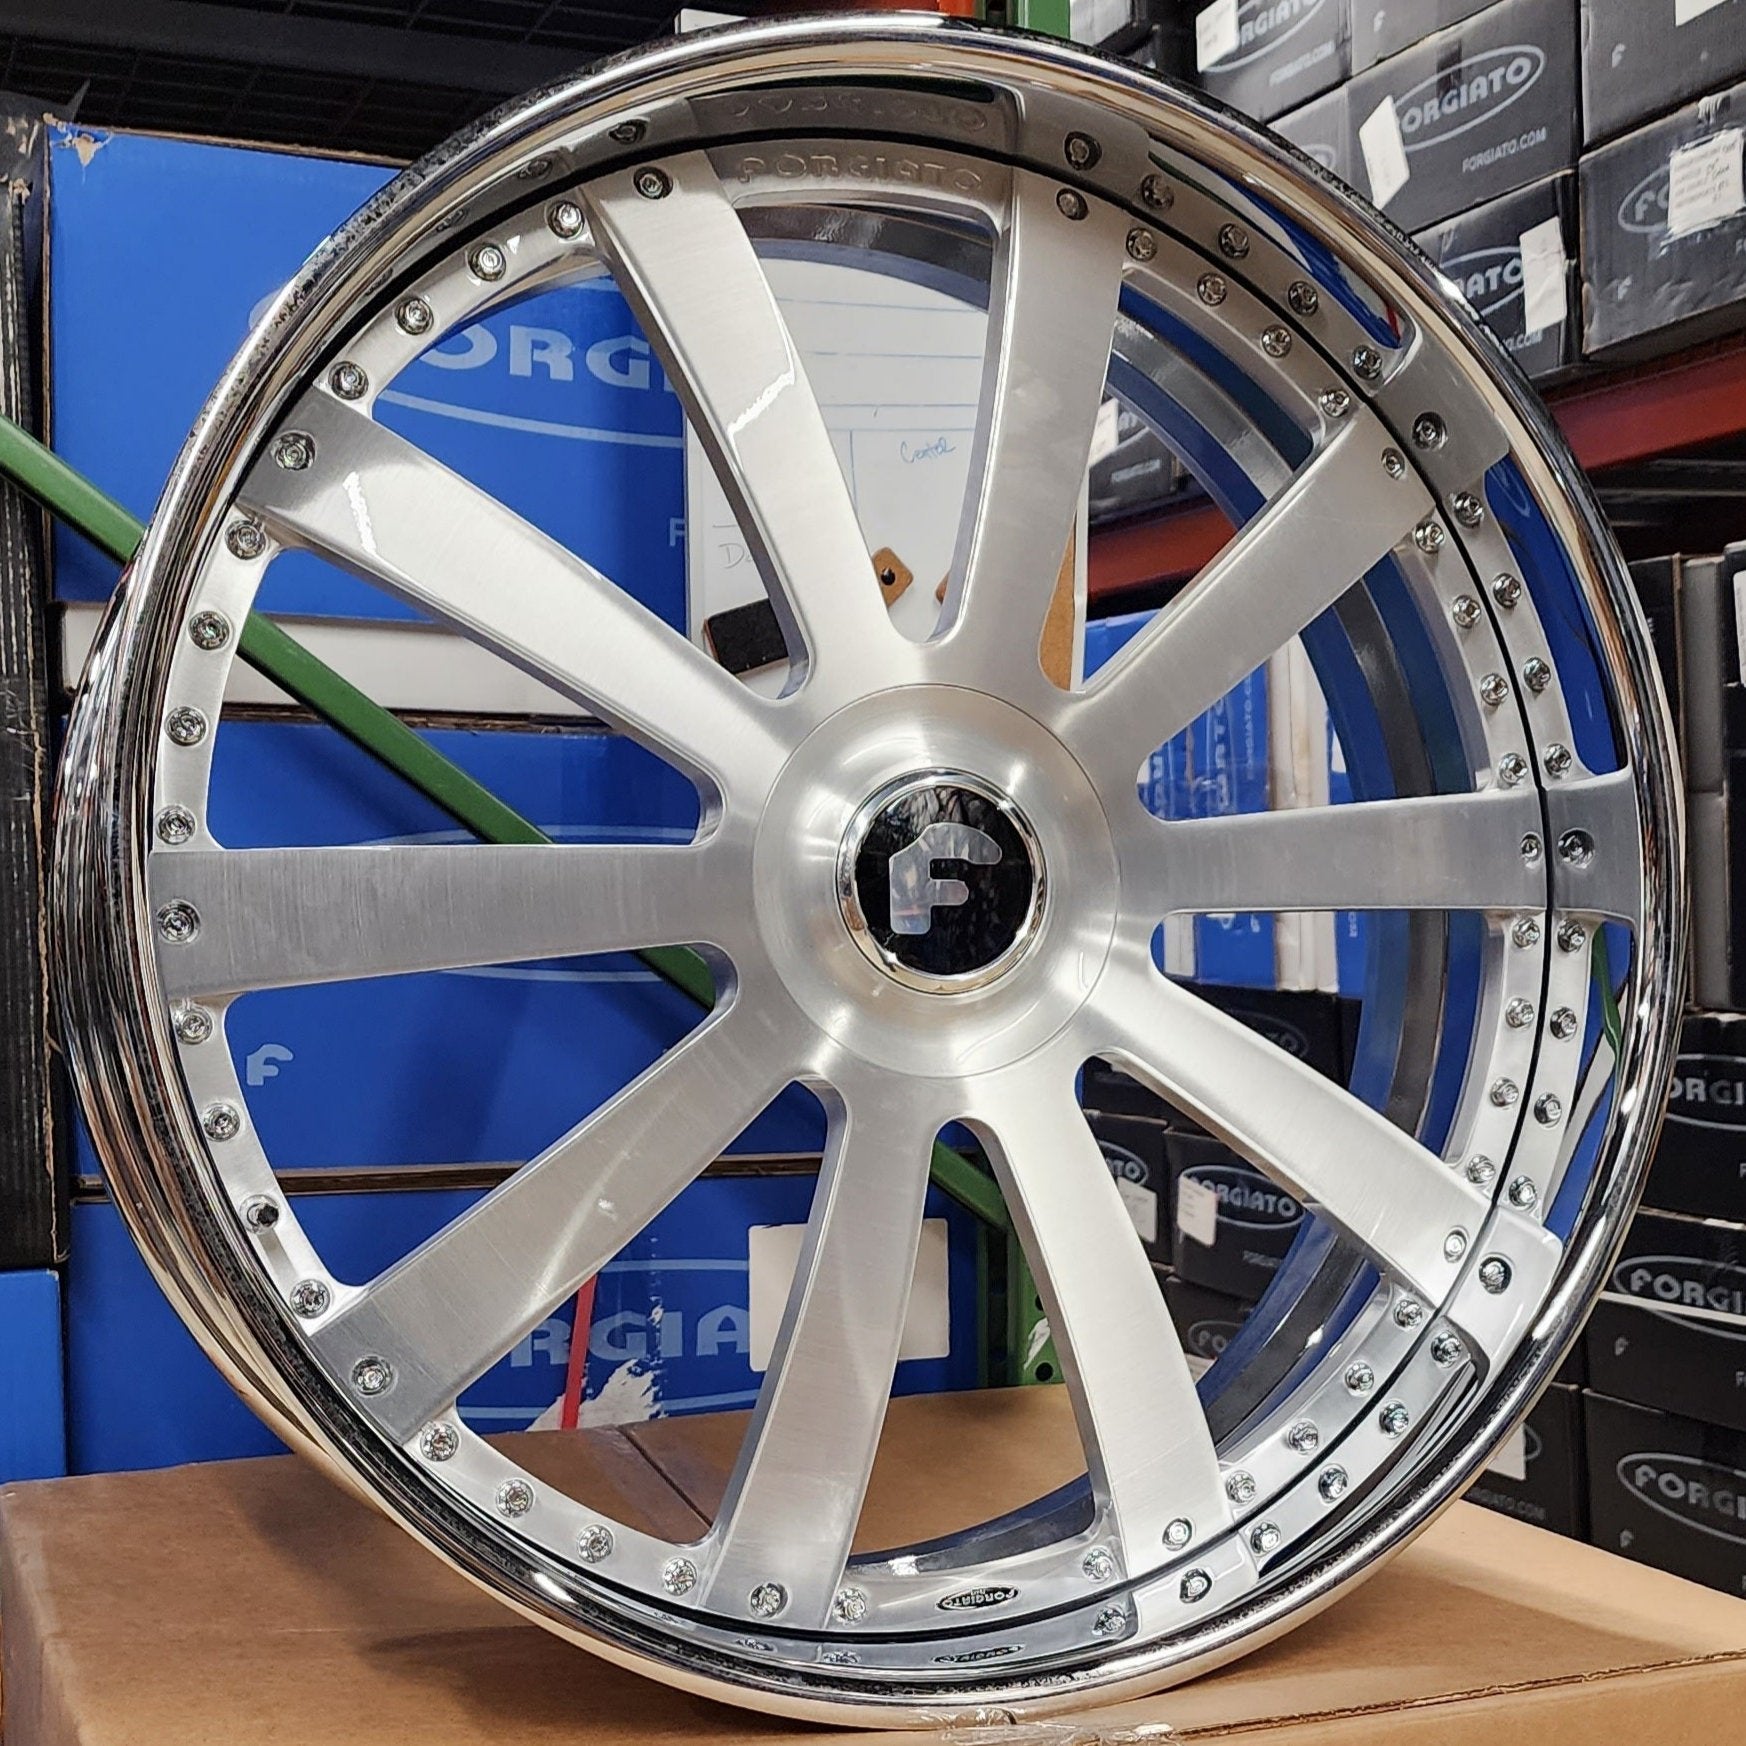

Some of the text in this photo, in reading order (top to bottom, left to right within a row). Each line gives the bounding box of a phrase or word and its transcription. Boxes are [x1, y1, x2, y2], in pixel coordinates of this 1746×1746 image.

[1240, 0, 1316, 46] RGIAT
[738, 153, 983, 191] FORGIATO
[1462, 126, 1547, 173] FORGIATO.COM
[888, 821, 1003, 935] F
[246, 1043, 294, 1086] F
